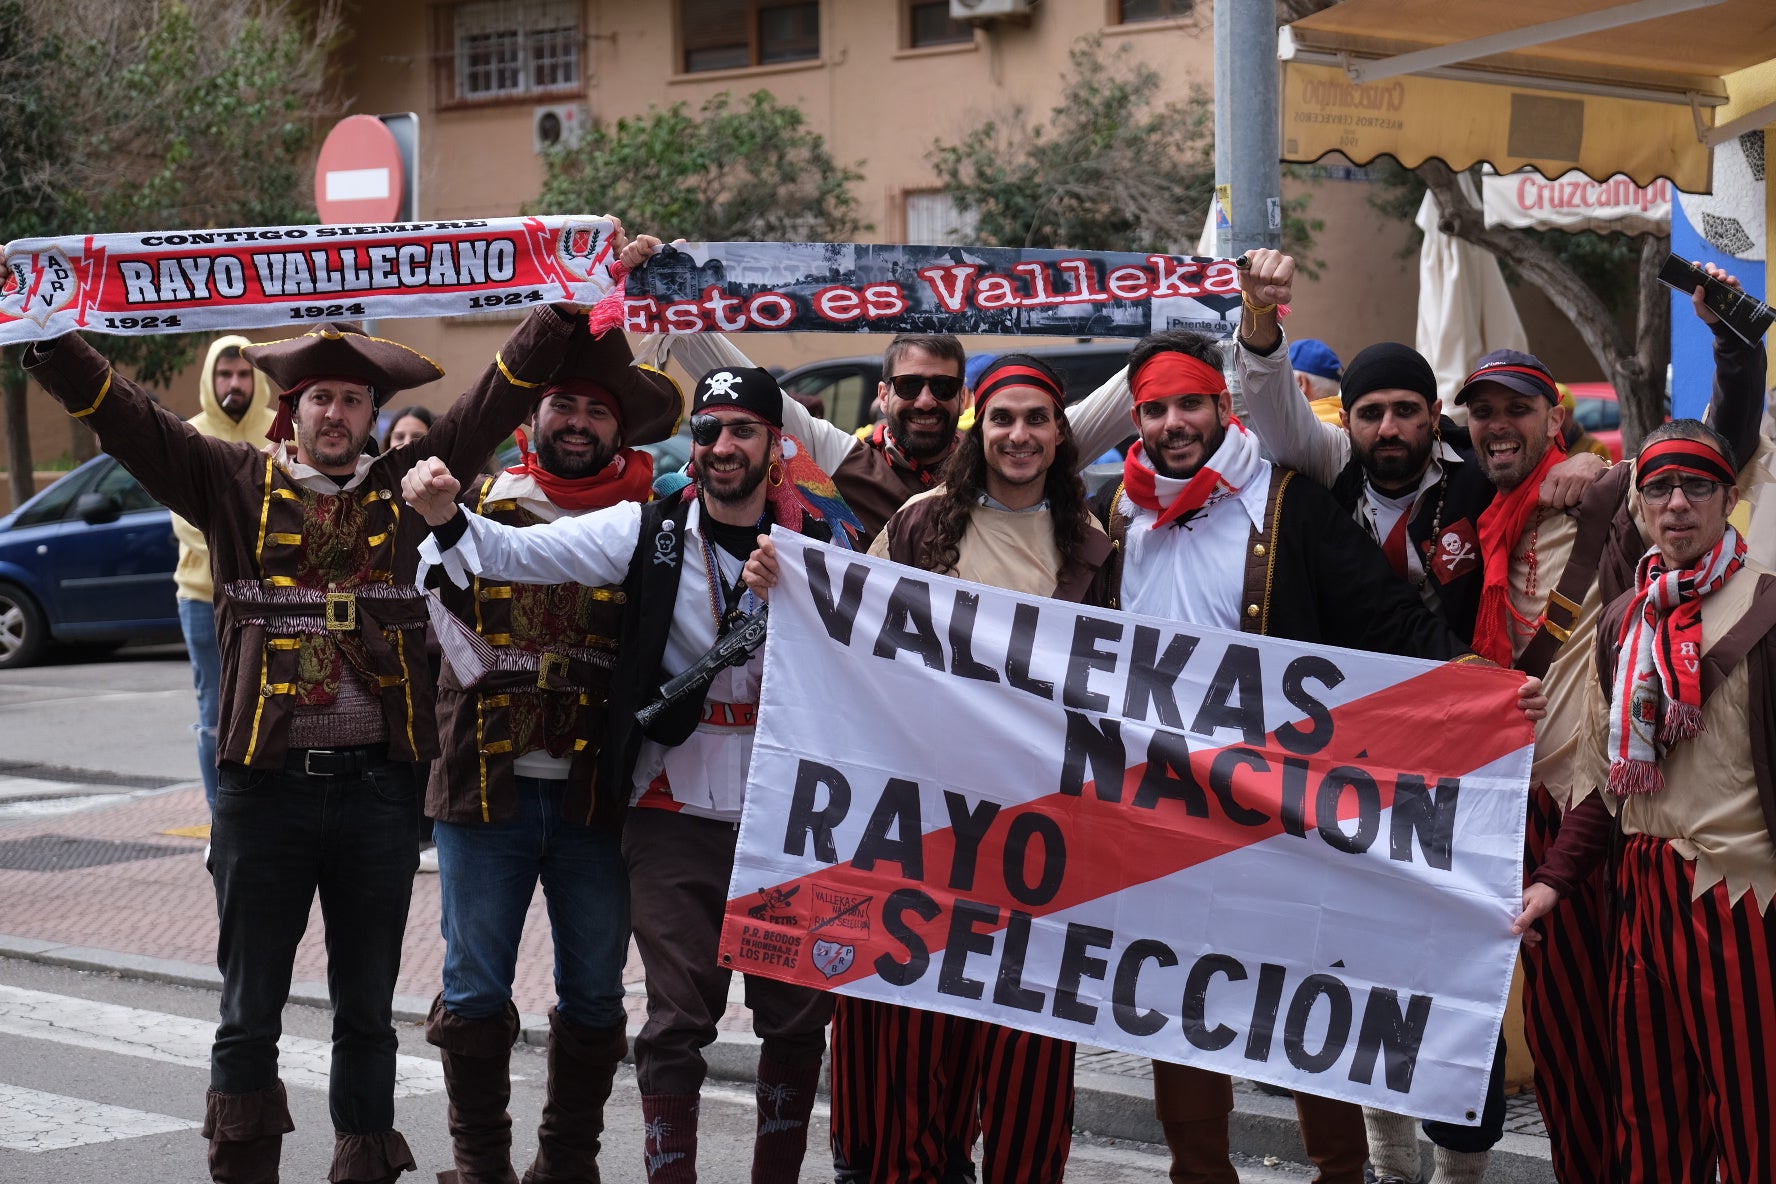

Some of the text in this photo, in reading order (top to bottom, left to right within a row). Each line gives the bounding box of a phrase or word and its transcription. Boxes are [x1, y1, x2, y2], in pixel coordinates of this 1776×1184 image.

[140, 219, 488, 247] CONTIGO SIEMPRE
[120, 239, 516, 305] RAYO VALLECANO
[468, 289, 544, 308] 1924
[624, 256, 1241, 334] Esto es Valleka
[104, 314, 182, 330] 1924
[290, 303, 366, 319] 1924
[1172, 318, 1212, 330] Puente
[1214, 321, 1228, 331] de
[803, 547, 1345, 755] VALLEKAS
[1059, 709, 1461, 871] NACIÓN
[783, 759, 1067, 907] RAYO
[815, 891, 857, 907] VALLEKAS
[743, 925, 801, 946] P.R. BEODOS
[739, 947, 797, 969] LOS PETAS
[741, 937, 799, 957] EN HOMENAJE A
[873, 888, 1434, 1095] SELECCIÓN
